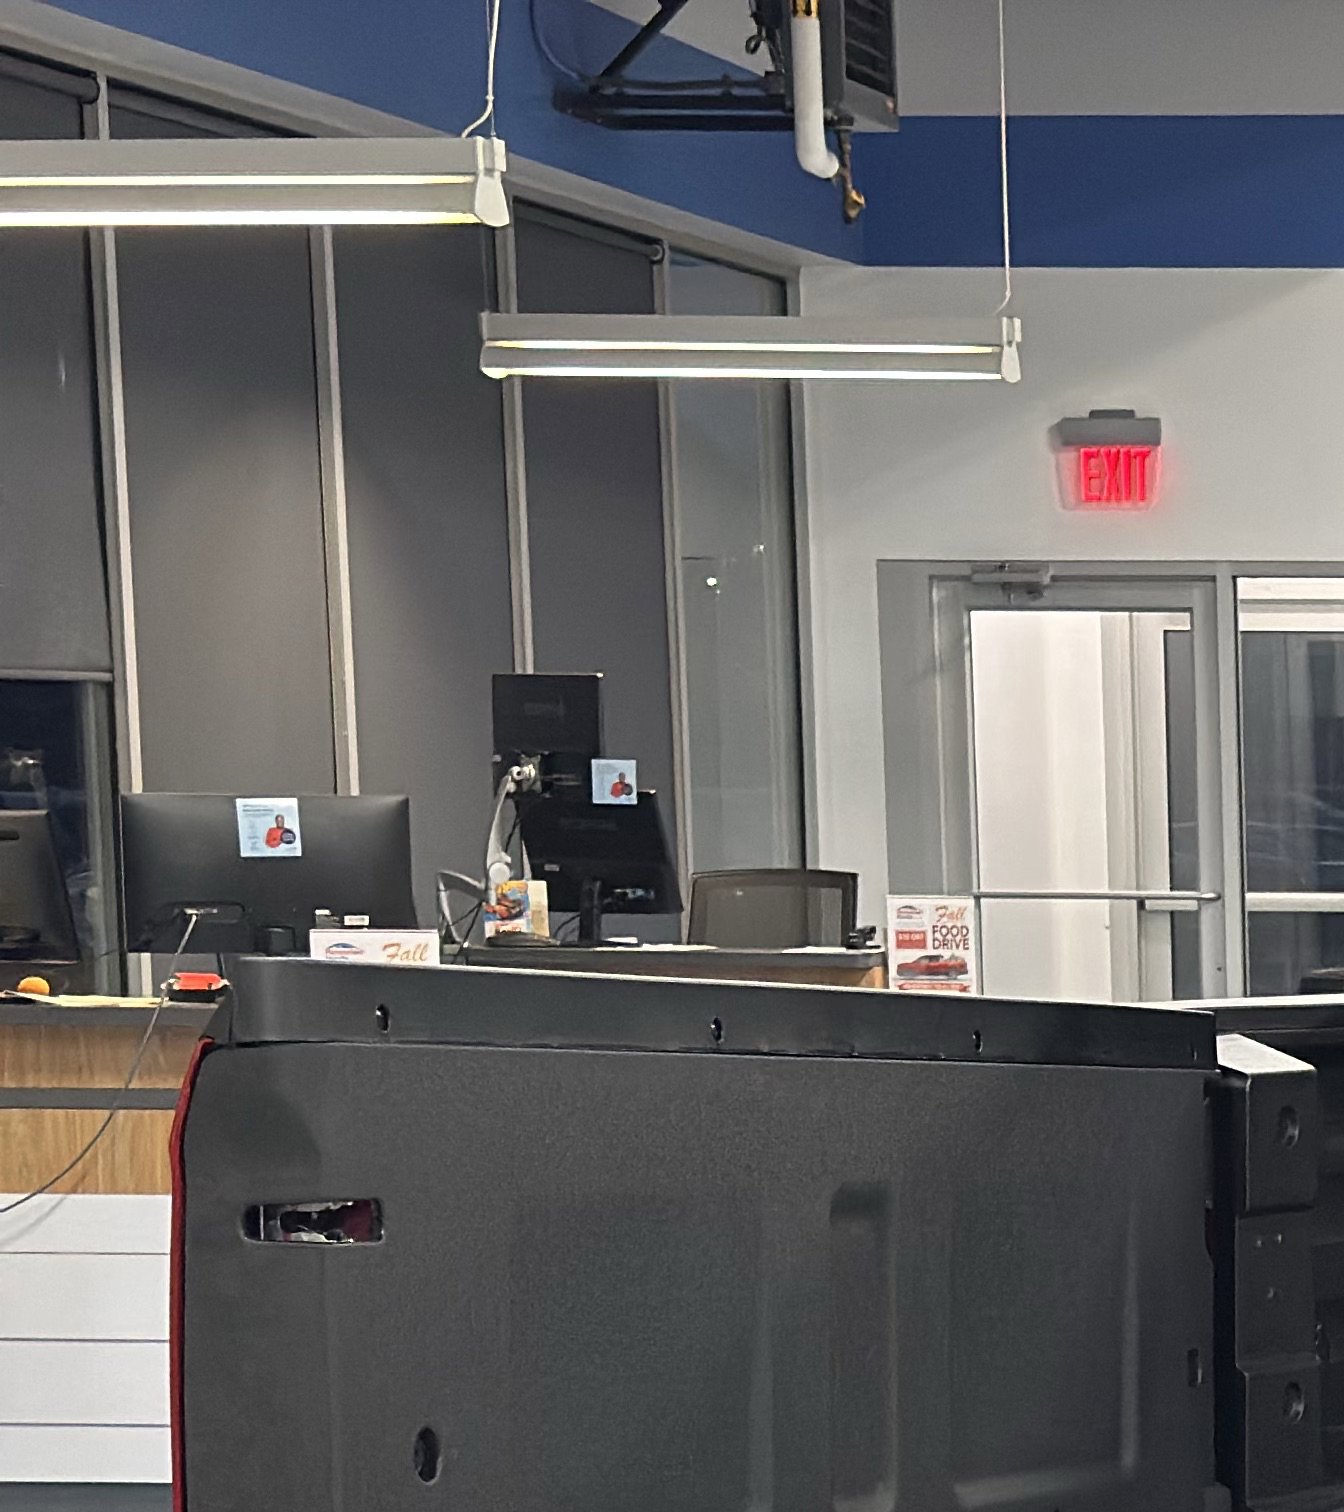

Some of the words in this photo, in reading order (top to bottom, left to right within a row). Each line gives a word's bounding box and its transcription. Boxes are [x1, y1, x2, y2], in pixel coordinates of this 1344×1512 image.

[1080, 448, 1151, 502] EXIT
[932, 925, 969, 938] FOOD
[932, 938, 970, 950] DRIVE
[382, 943, 428, 963] Fall
